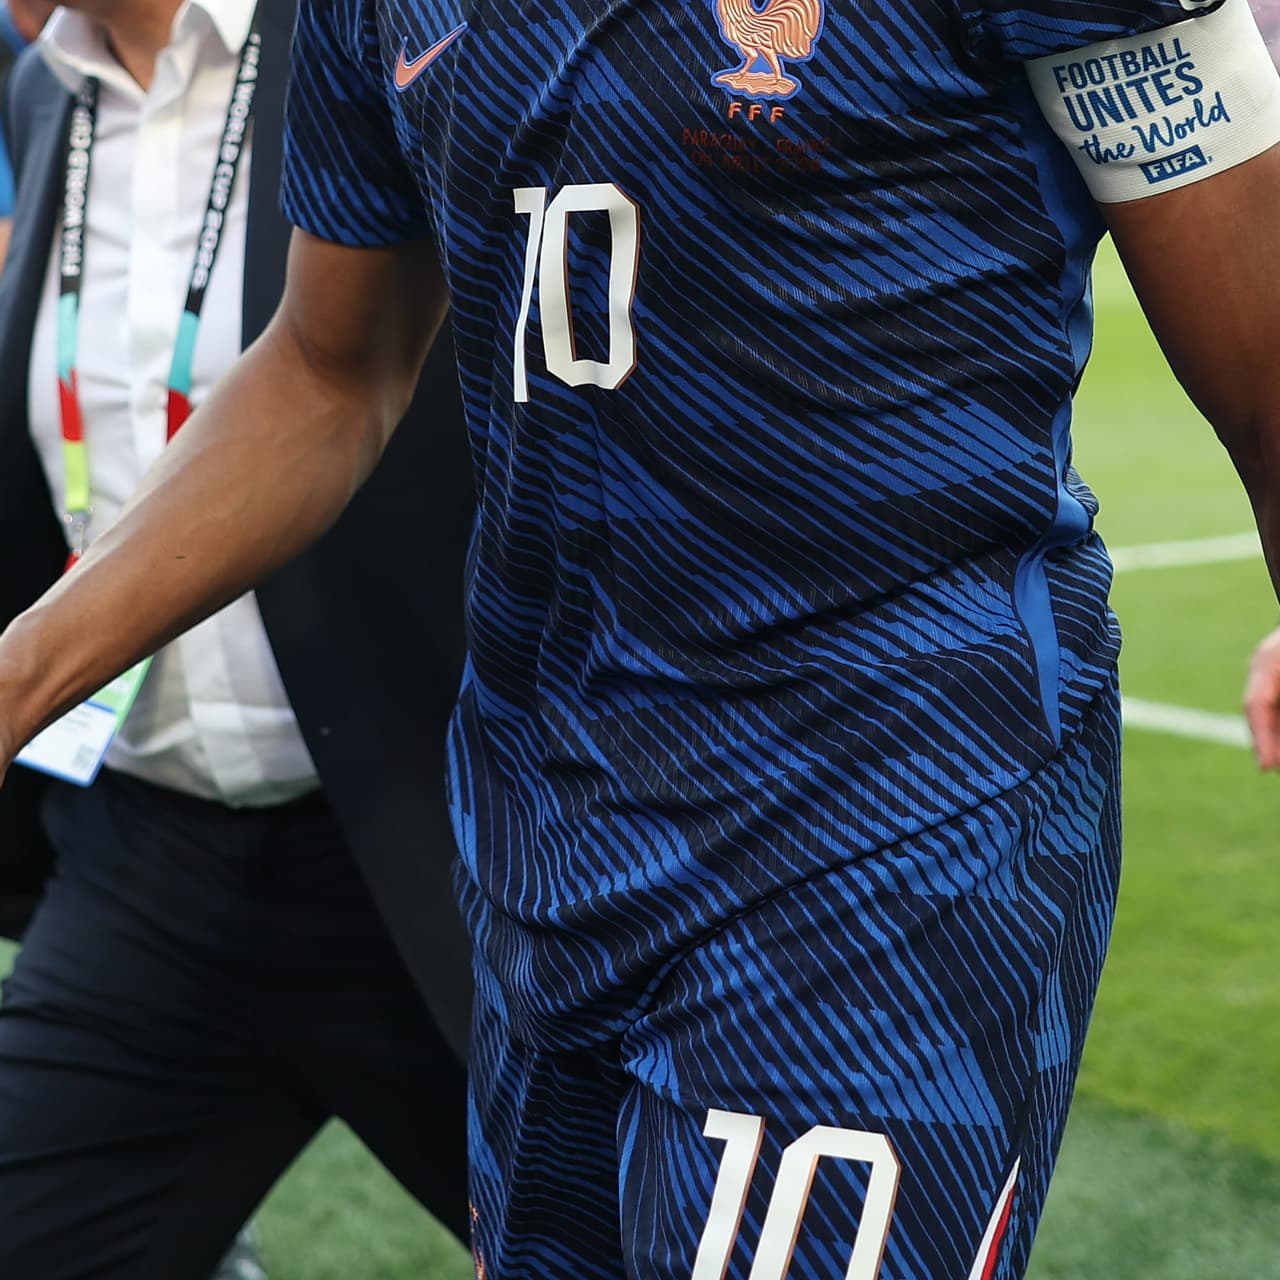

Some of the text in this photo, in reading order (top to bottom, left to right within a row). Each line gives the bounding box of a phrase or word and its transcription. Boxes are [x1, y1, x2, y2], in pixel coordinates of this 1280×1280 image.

[1053, 38, 1191, 93] FOOTBALL
[1063, 61, 1203, 132] UNITES
[70, 105, 93, 150] CUP
[220, 79, 256, 162] WORLD
[1079, 91, 1231, 165] the World
[63, 148, 89, 229] WORLD
[211, 161, 234, 210] CUP
[1145, 150, 1203, 179] FIFA
[62, 226, 83, 277] FIFA
[191, 207, 224, 291] 2026
[513, 183, 641, 403] 10
[691, 1108, 902, 1280] 10
